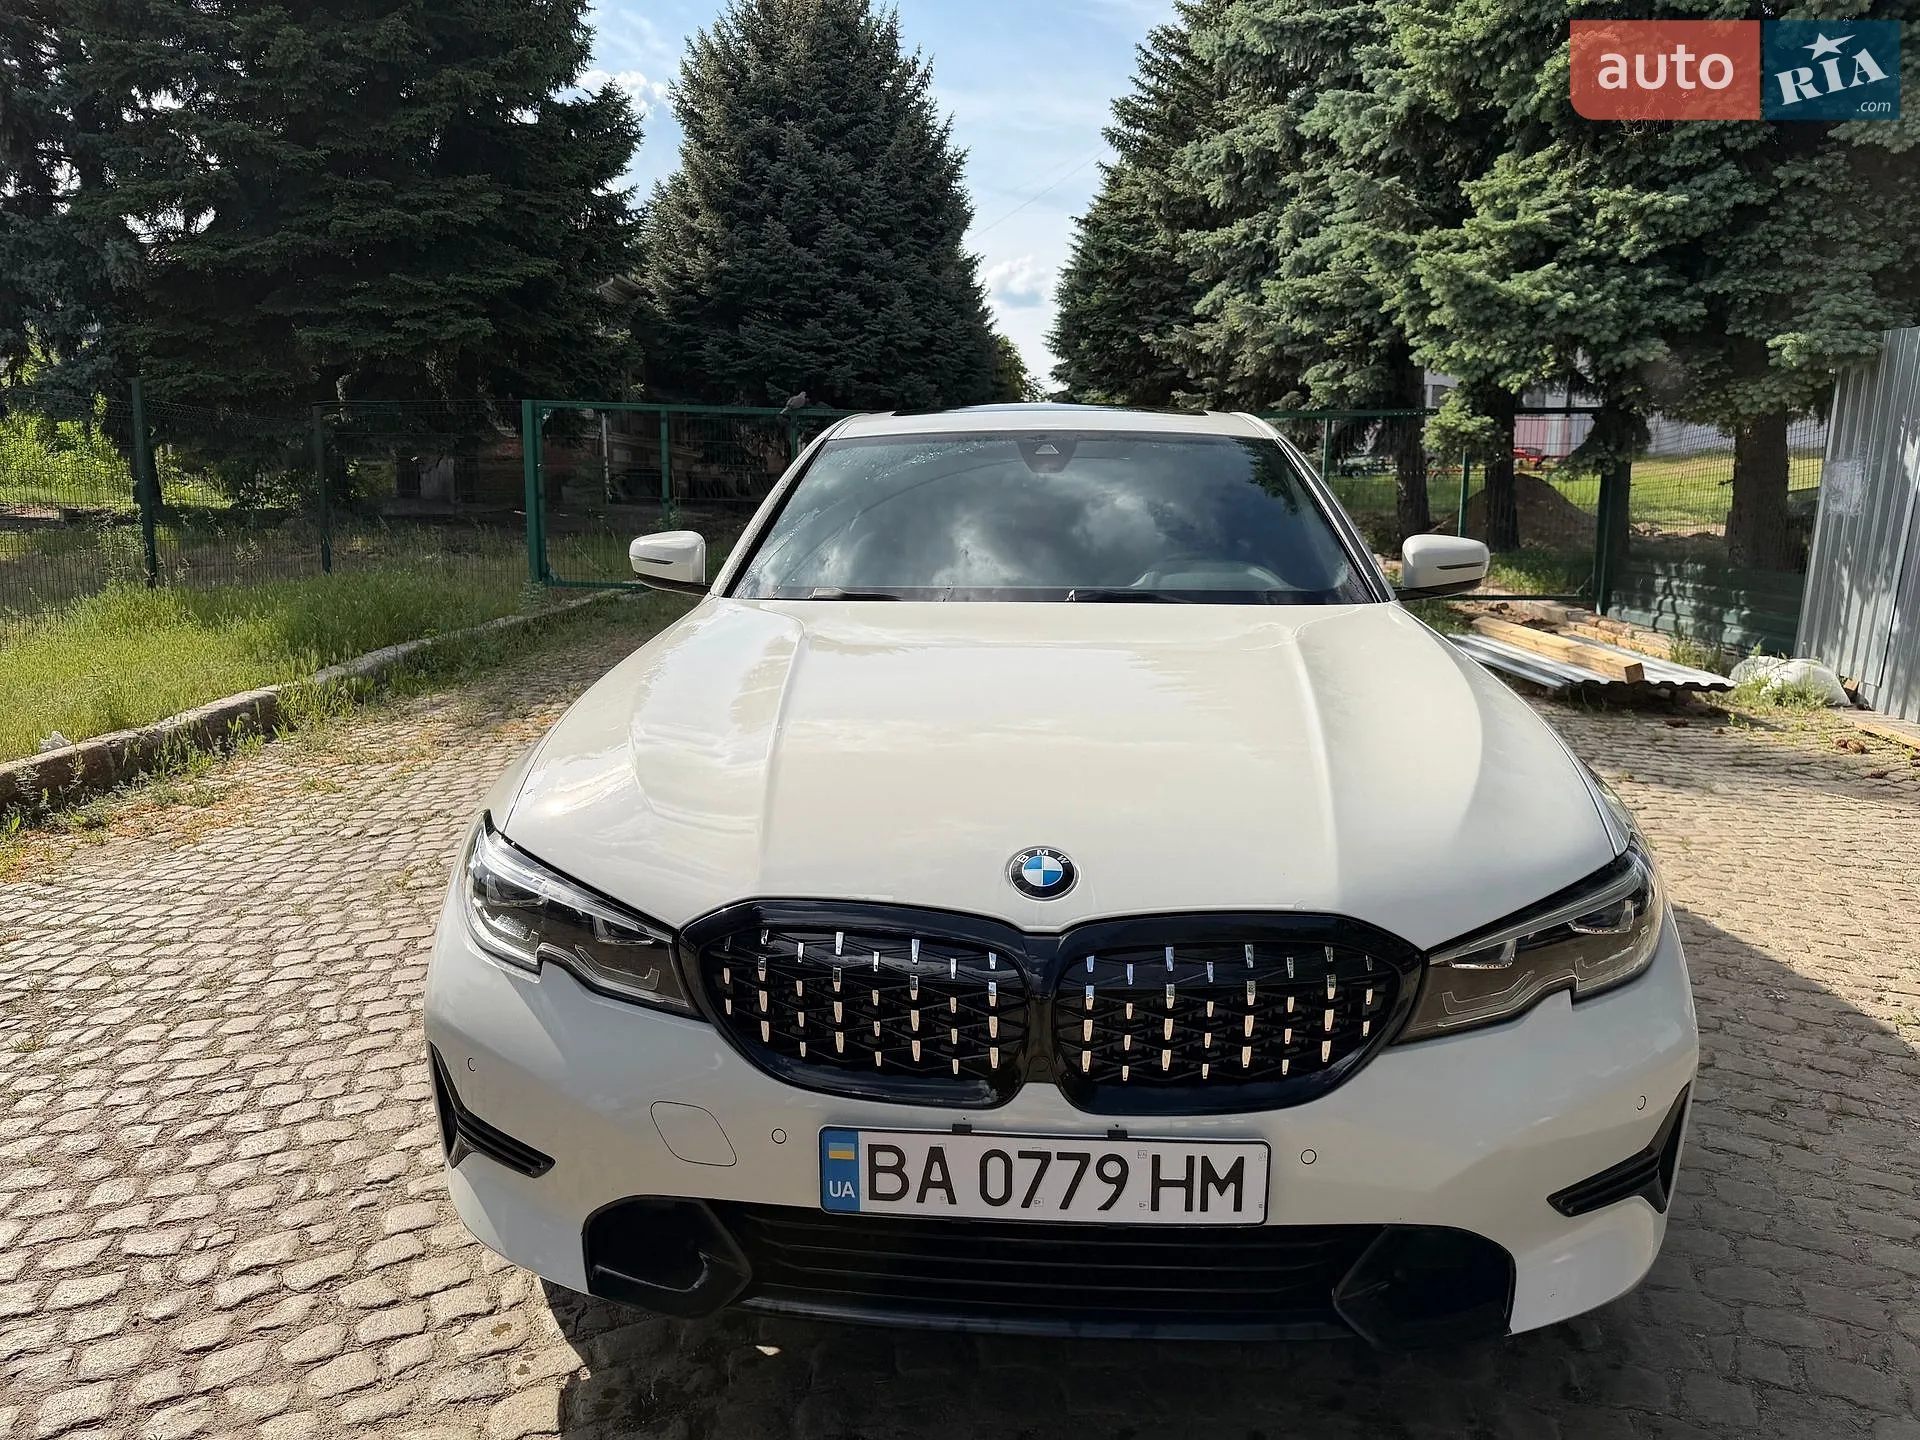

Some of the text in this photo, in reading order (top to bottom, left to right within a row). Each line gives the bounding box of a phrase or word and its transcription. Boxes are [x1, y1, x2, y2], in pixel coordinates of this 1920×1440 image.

[1017, 849, 1069, 864] BMW
[867, 1144, 1245, 1212] BA 0779 HM
[829, 1180, 856, 1199] UA
